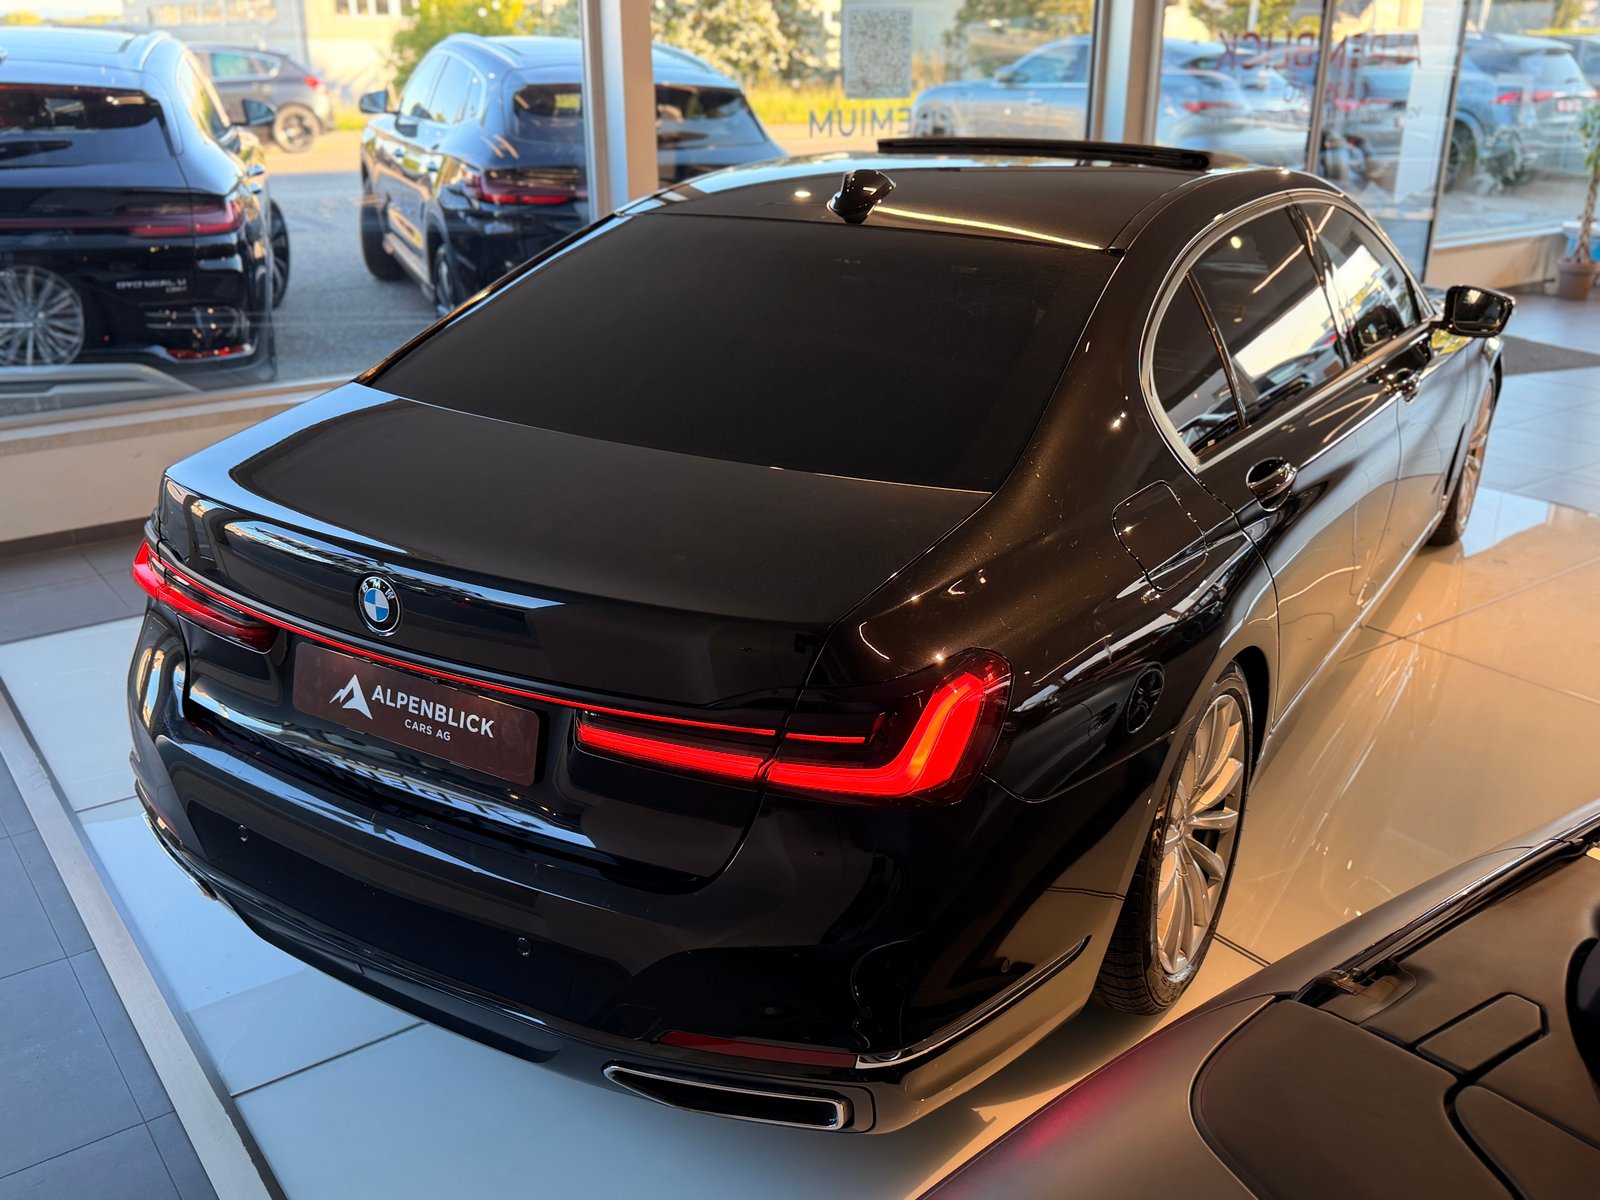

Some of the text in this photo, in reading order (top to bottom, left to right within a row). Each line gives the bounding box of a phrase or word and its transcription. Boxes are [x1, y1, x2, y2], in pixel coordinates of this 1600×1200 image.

[361, 578, 396, 600] BMW
[371, 684, 495, 739] ALPENBLICK
[404, 718, 451, 742] CARS AG
